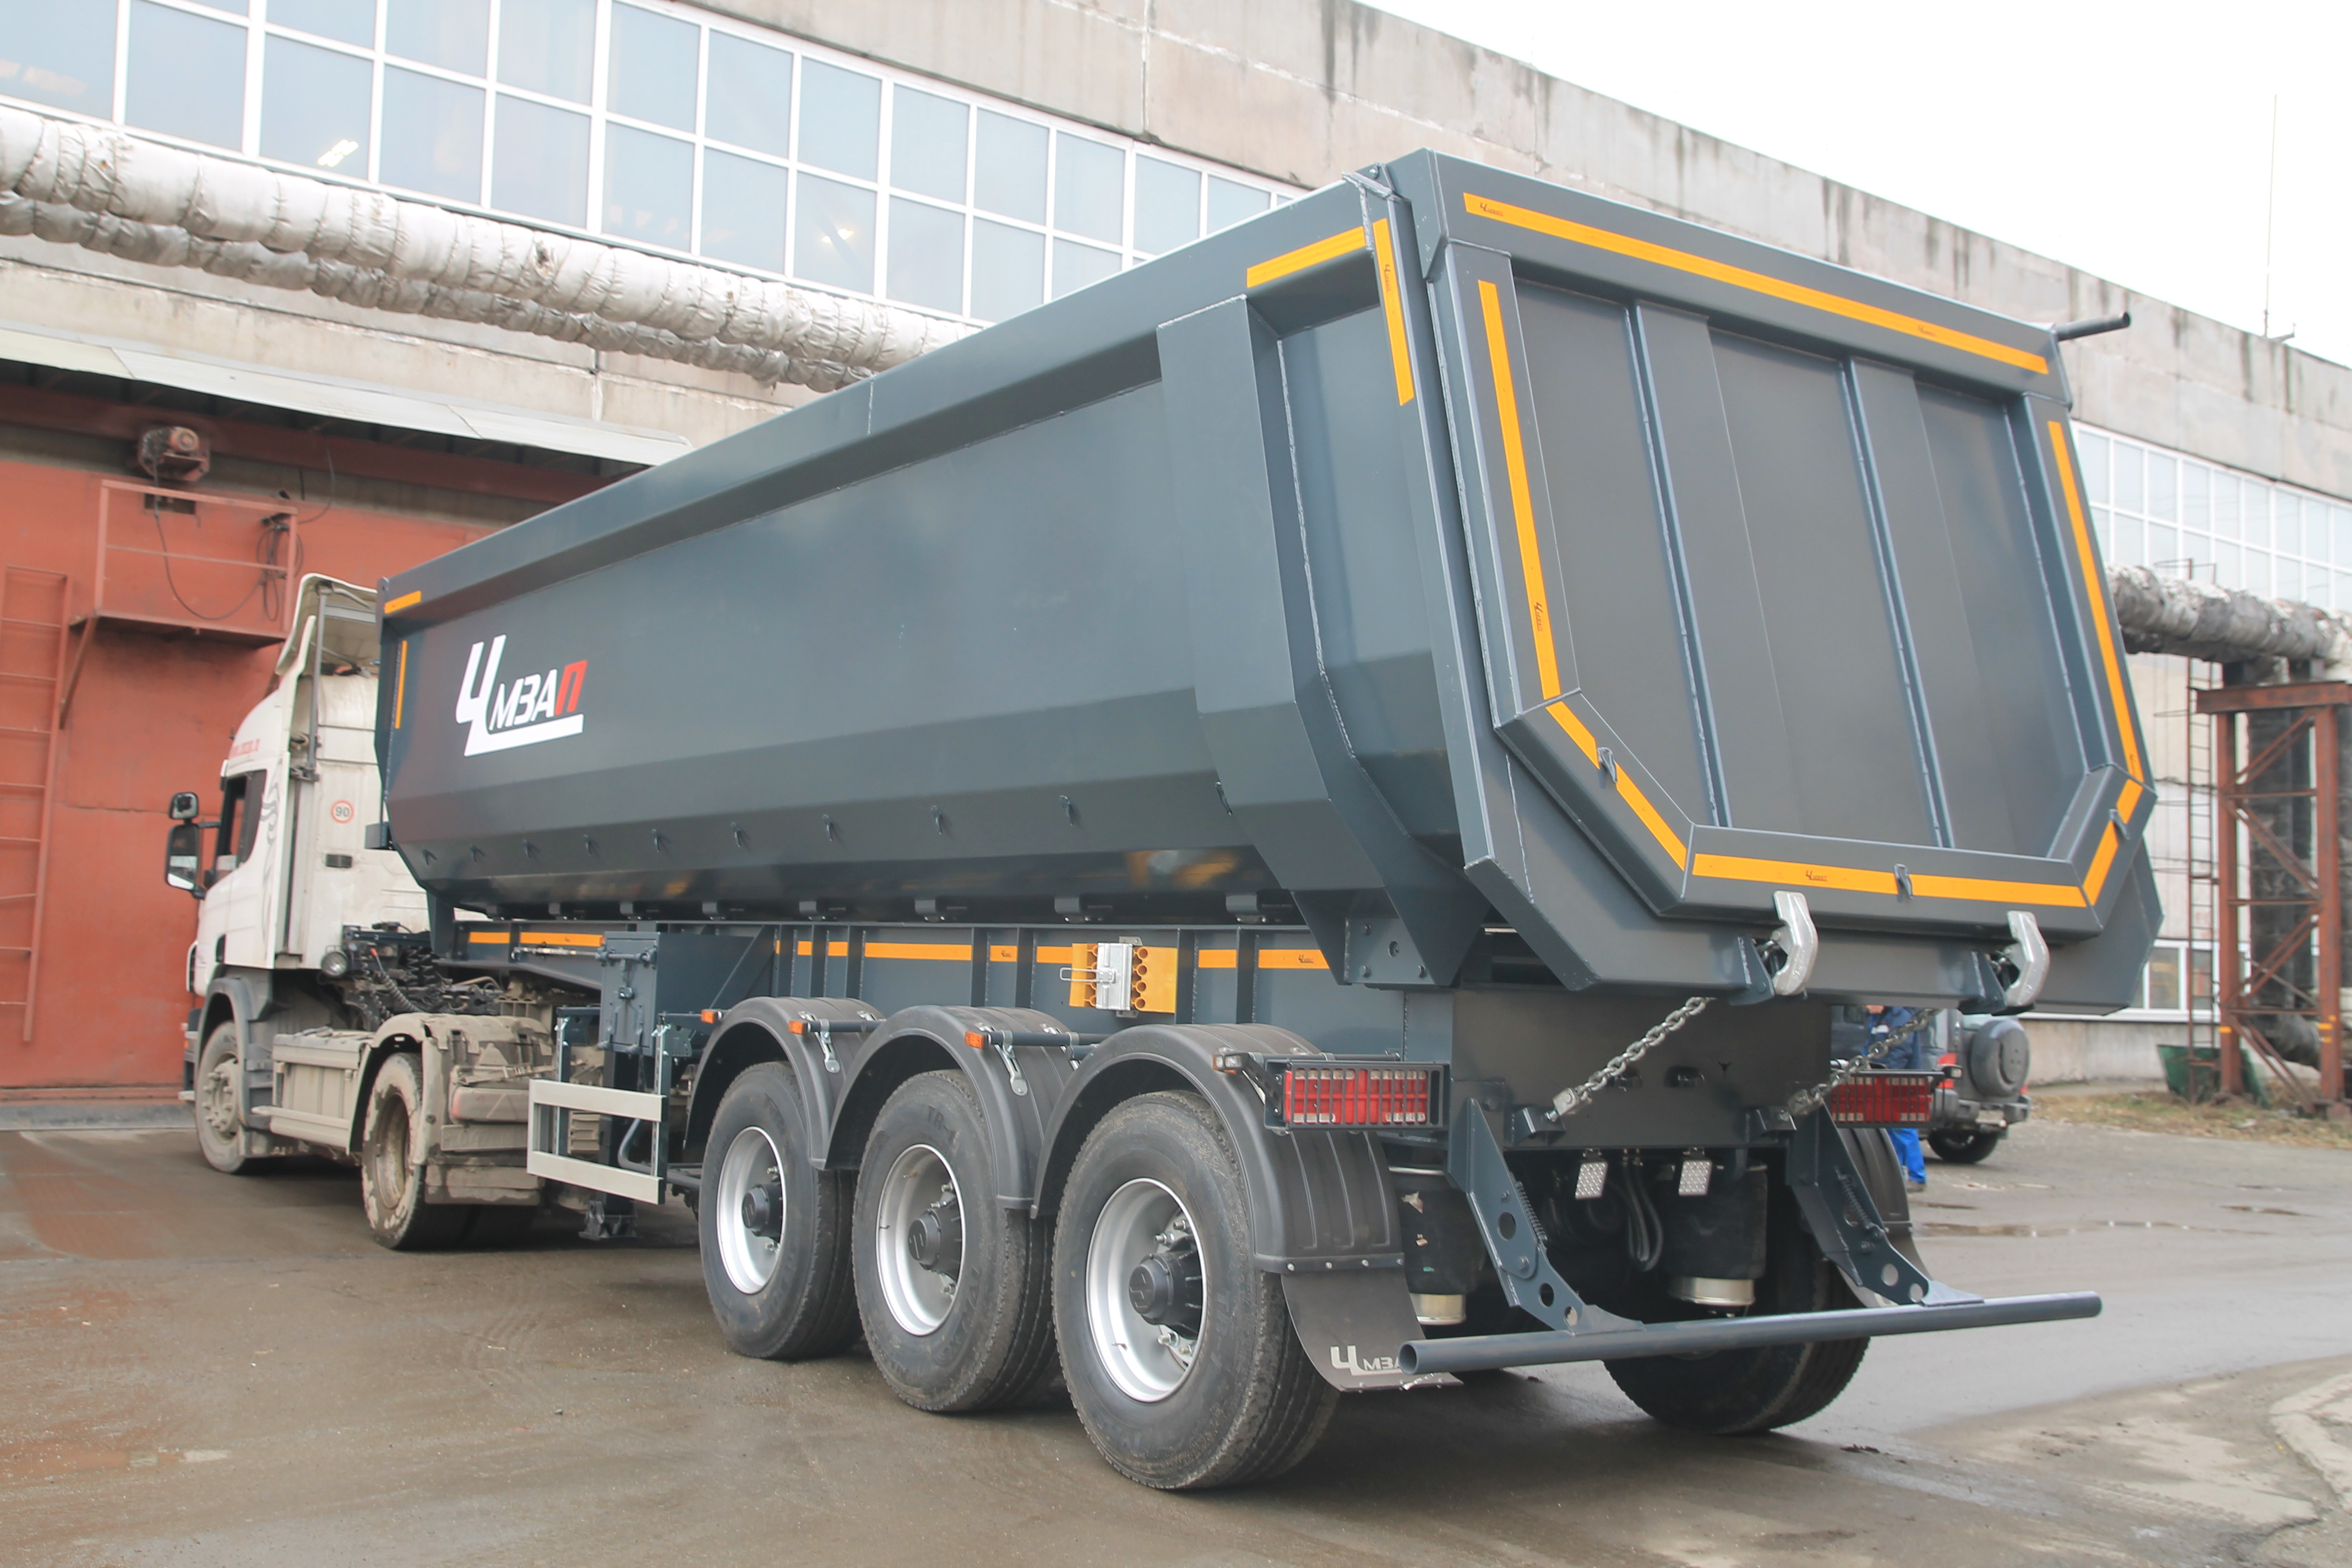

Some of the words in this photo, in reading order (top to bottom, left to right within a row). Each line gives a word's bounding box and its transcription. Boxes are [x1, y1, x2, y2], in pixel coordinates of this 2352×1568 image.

[455, 634, 587, 756] ЧМЗАП
[335, 806, 350, 818] 90
[1330, 1345, 1403, 1376] ЧМЗ
